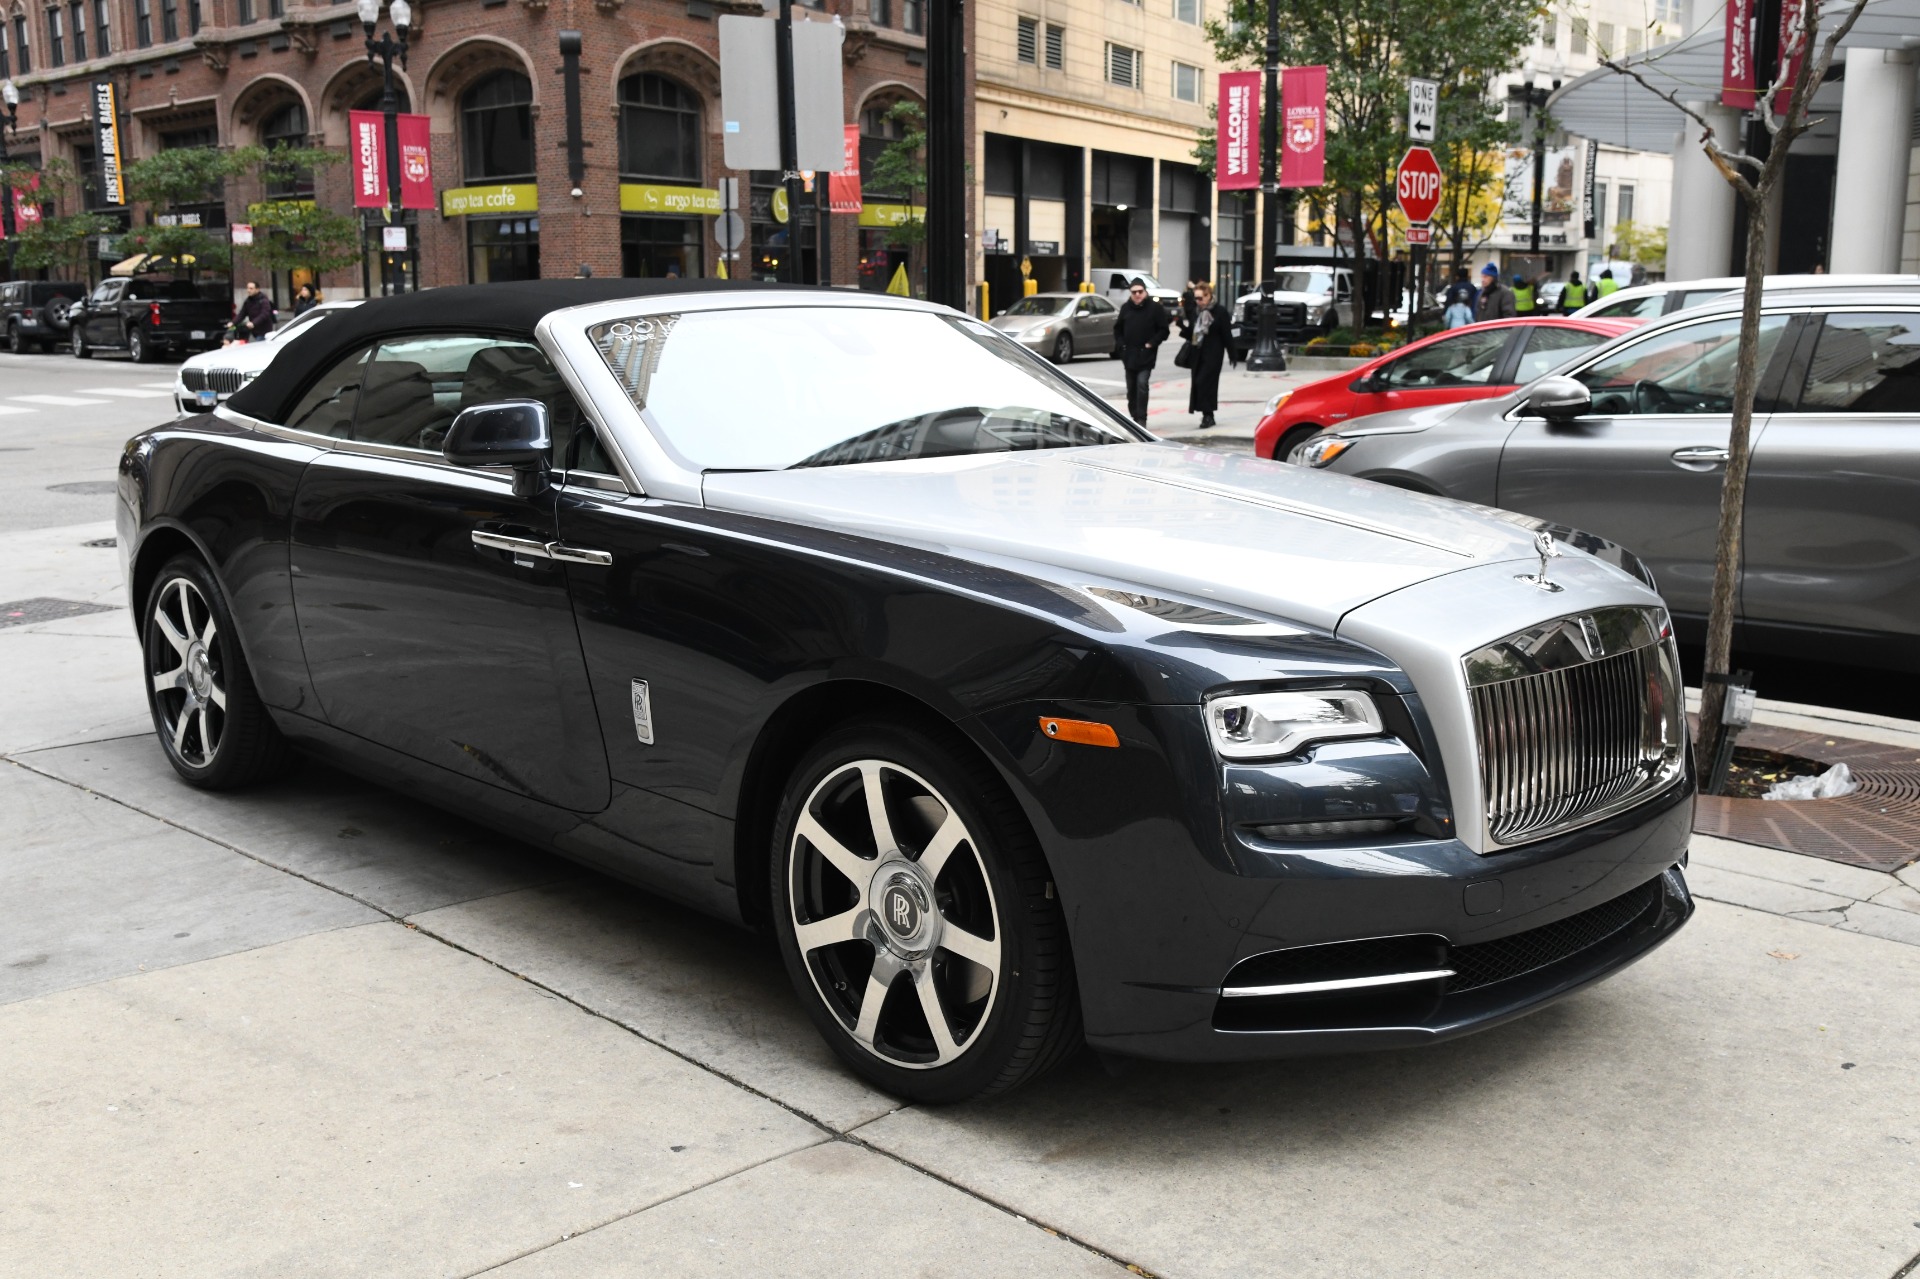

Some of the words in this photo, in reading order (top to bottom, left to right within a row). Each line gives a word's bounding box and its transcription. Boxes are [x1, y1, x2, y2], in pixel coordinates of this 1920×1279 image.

[97, 84, 113, 124] BAGELS
[1242, 86, 1250, 119] CAMPUS
[1413, 84, 1433, 101] ONE
[1287, 106, 1320, 115] LOYOLA
[1412, 102, 1433, 117] WAY
[1228, 86, 1242, 175] WELCOME
[359, 123, 374, 195] WELCOME
[103, 156, 119, 203] EINSTEIN
[1400, 170, 1439, 200] STOP
[452, 196, 467, 213] argo
[468, 194, 484, 208] tea
[486, 186, 516, 207] café
[664, 194, 691, 211] argo
[692, 193, 705, 208] tea
[615, 333, 657, 342] TRADE
